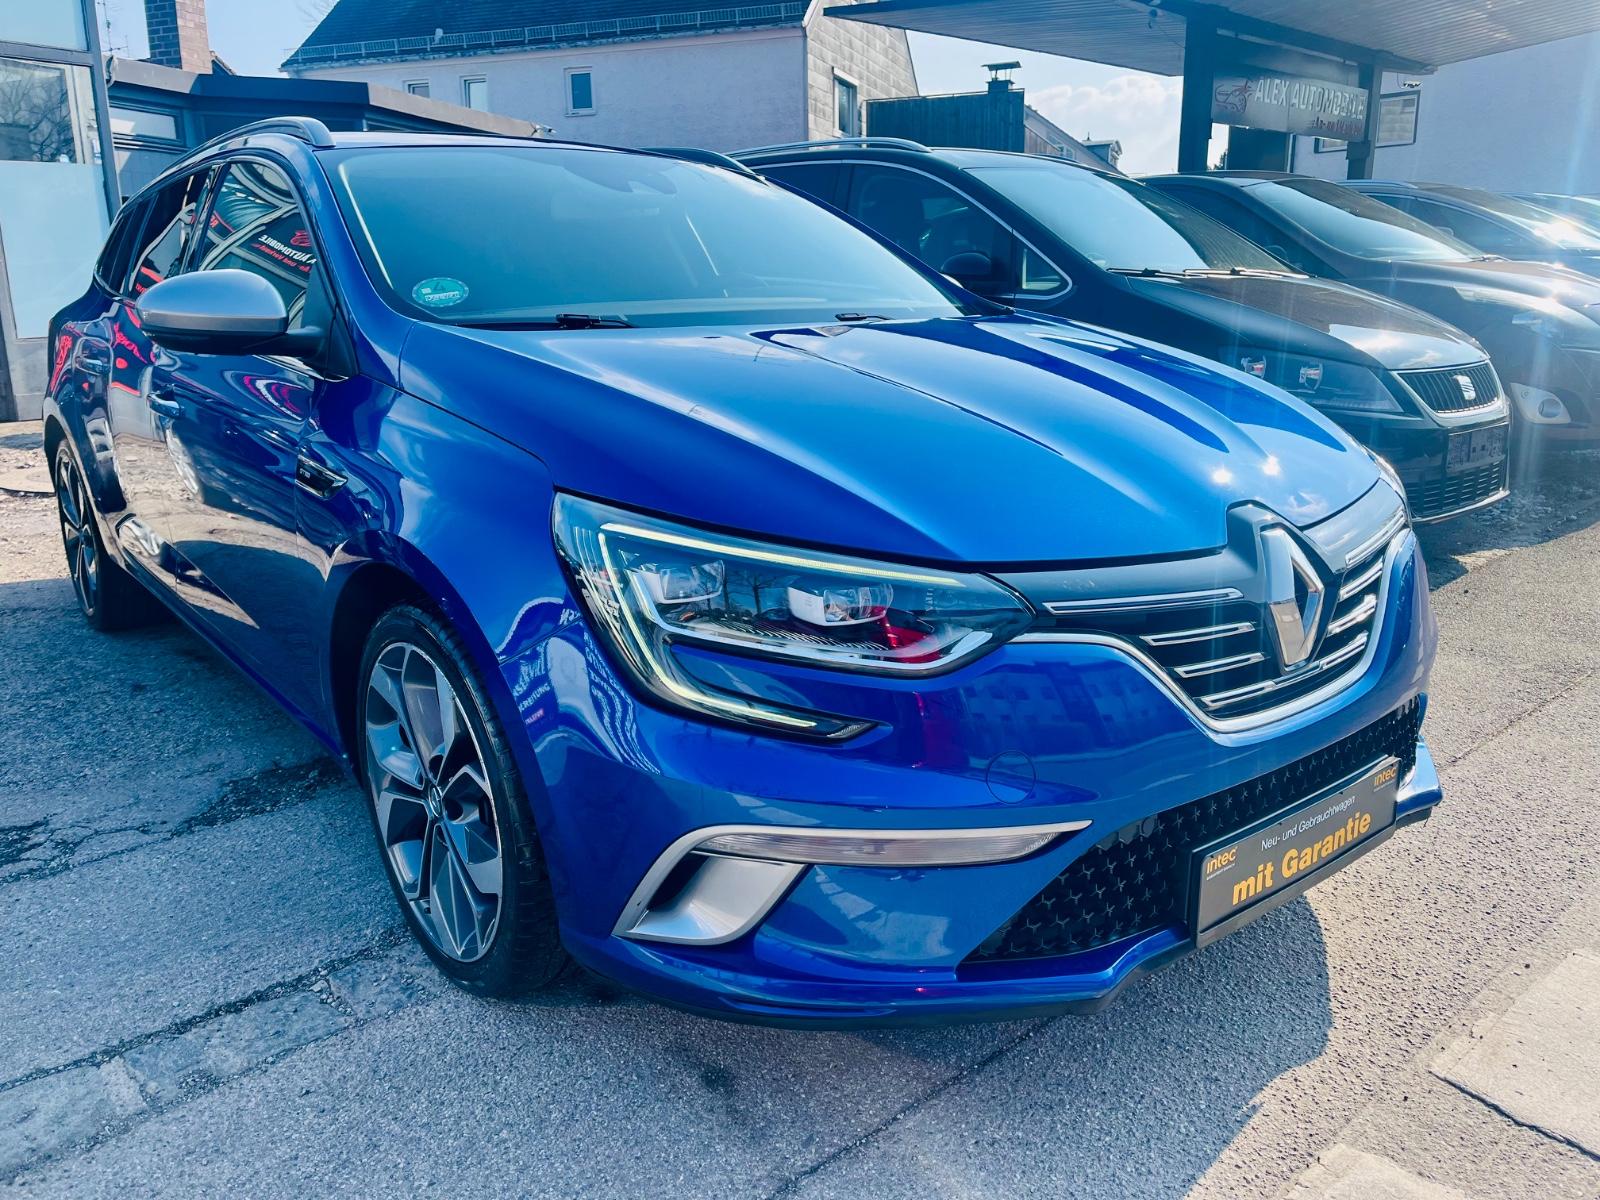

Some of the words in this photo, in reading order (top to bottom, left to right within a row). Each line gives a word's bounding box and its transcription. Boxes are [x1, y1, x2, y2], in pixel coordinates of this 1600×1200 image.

[1255, 79, 1289, 106] ALEX
[1291, 83, 1366, 119] AUTOMOBILE
[1261, 836, 1281, 851] Neu-
[1281, 825, 1298, 841] und
[1232, 861, 1274, 906] mit
[1281, 812, 1371, 879] Garantie
